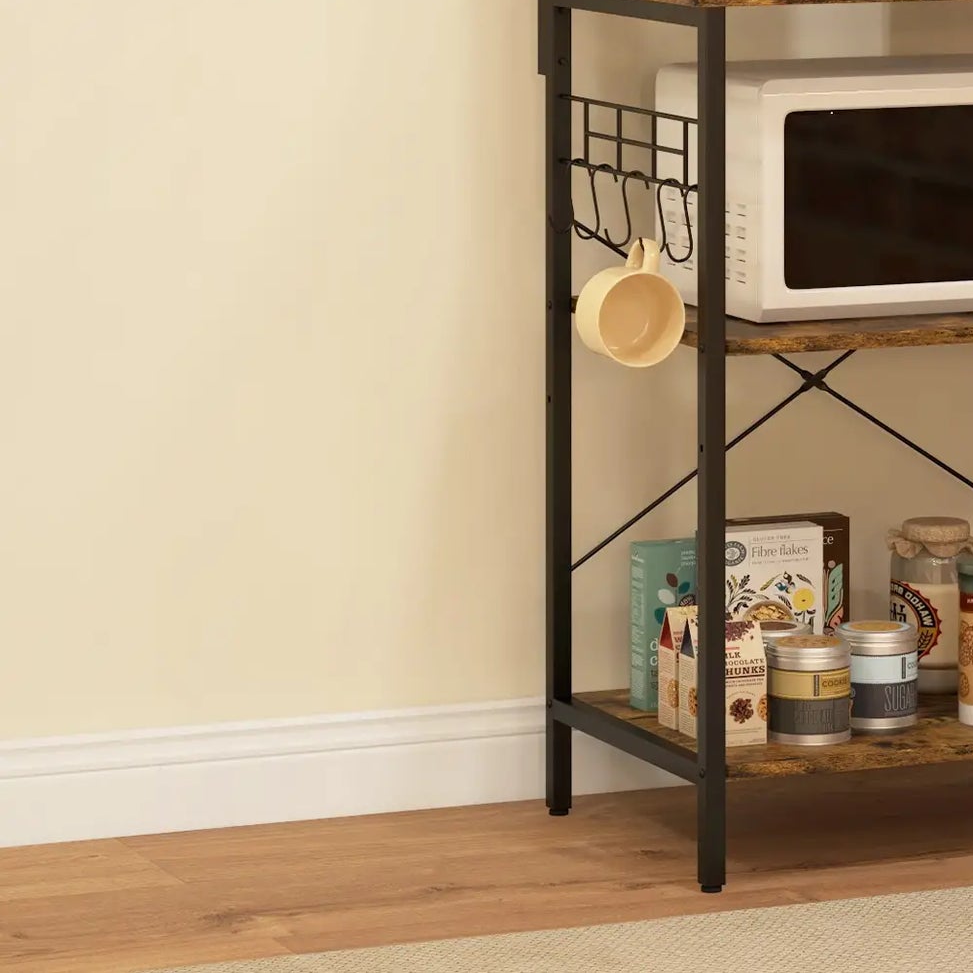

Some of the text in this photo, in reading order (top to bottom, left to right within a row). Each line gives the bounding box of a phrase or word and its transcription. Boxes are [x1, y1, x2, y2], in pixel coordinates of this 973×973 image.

[822, 534, 834, 545] ce
[751, 545, 778, 558] Fibre
[779, 544, 809, 556] flakes
[726, 658, 765, 666] OCOLATE
[726, 665, 766, 676] HUNKS
